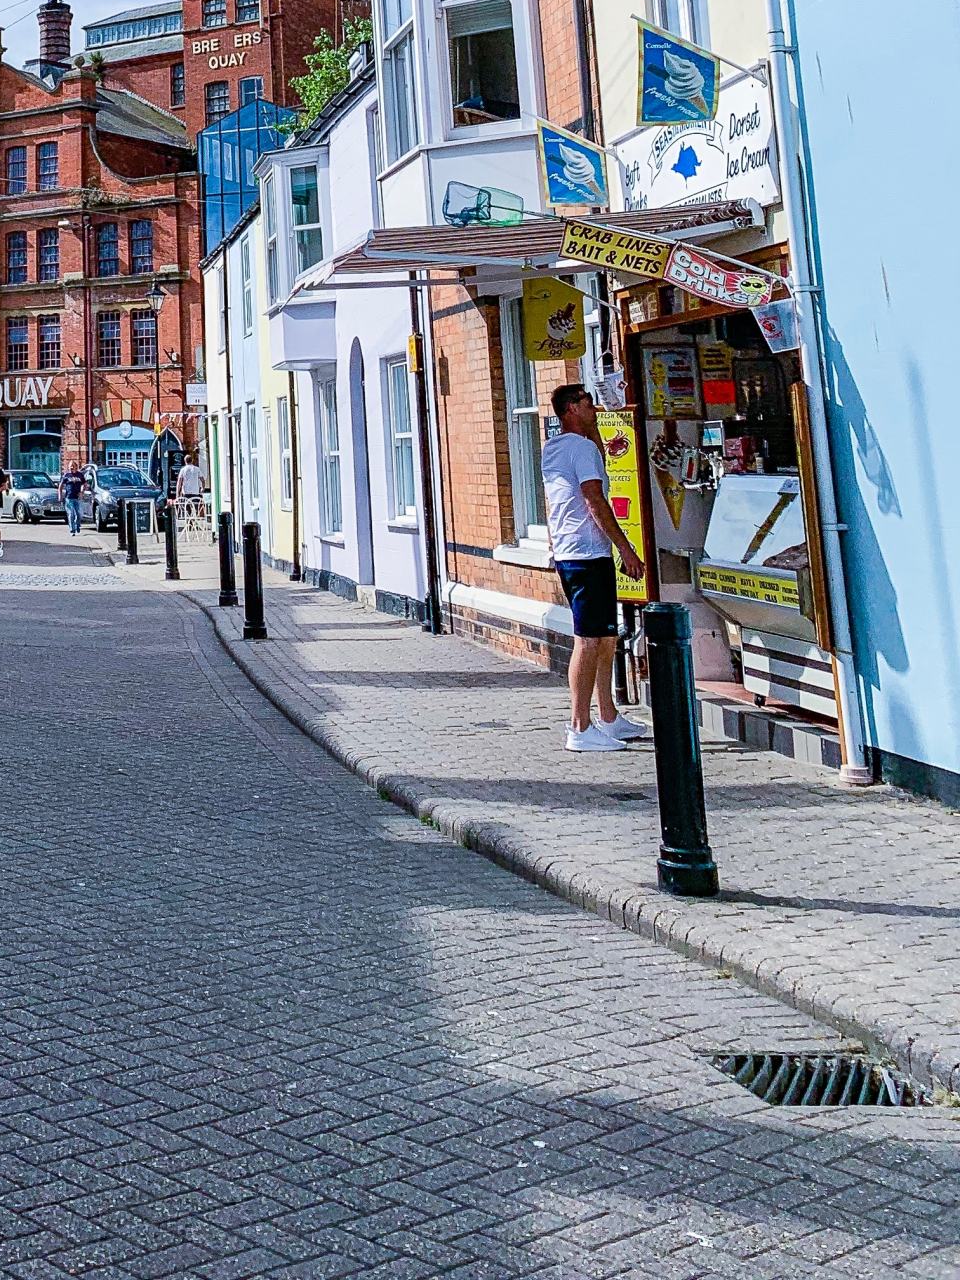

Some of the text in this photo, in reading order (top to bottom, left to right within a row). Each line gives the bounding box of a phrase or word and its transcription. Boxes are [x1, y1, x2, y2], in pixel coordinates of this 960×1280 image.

[192, 31, 262, 55] BRE ERS
[208, 51, 246, 70] QUAY
[644, 86, 679, 108] freshly
[728, 102, 761, 141] Dorset
[726, 145, 771, 179] Ice Cream
[570, 224, 665, 256] CRAB LINES
[565, 240, 662, 274] BAIT & NETS
[674, 249, 726, 287] Cold
[669, 264, 750, 304] Drinks
[549, 349, 563, 357] 99
